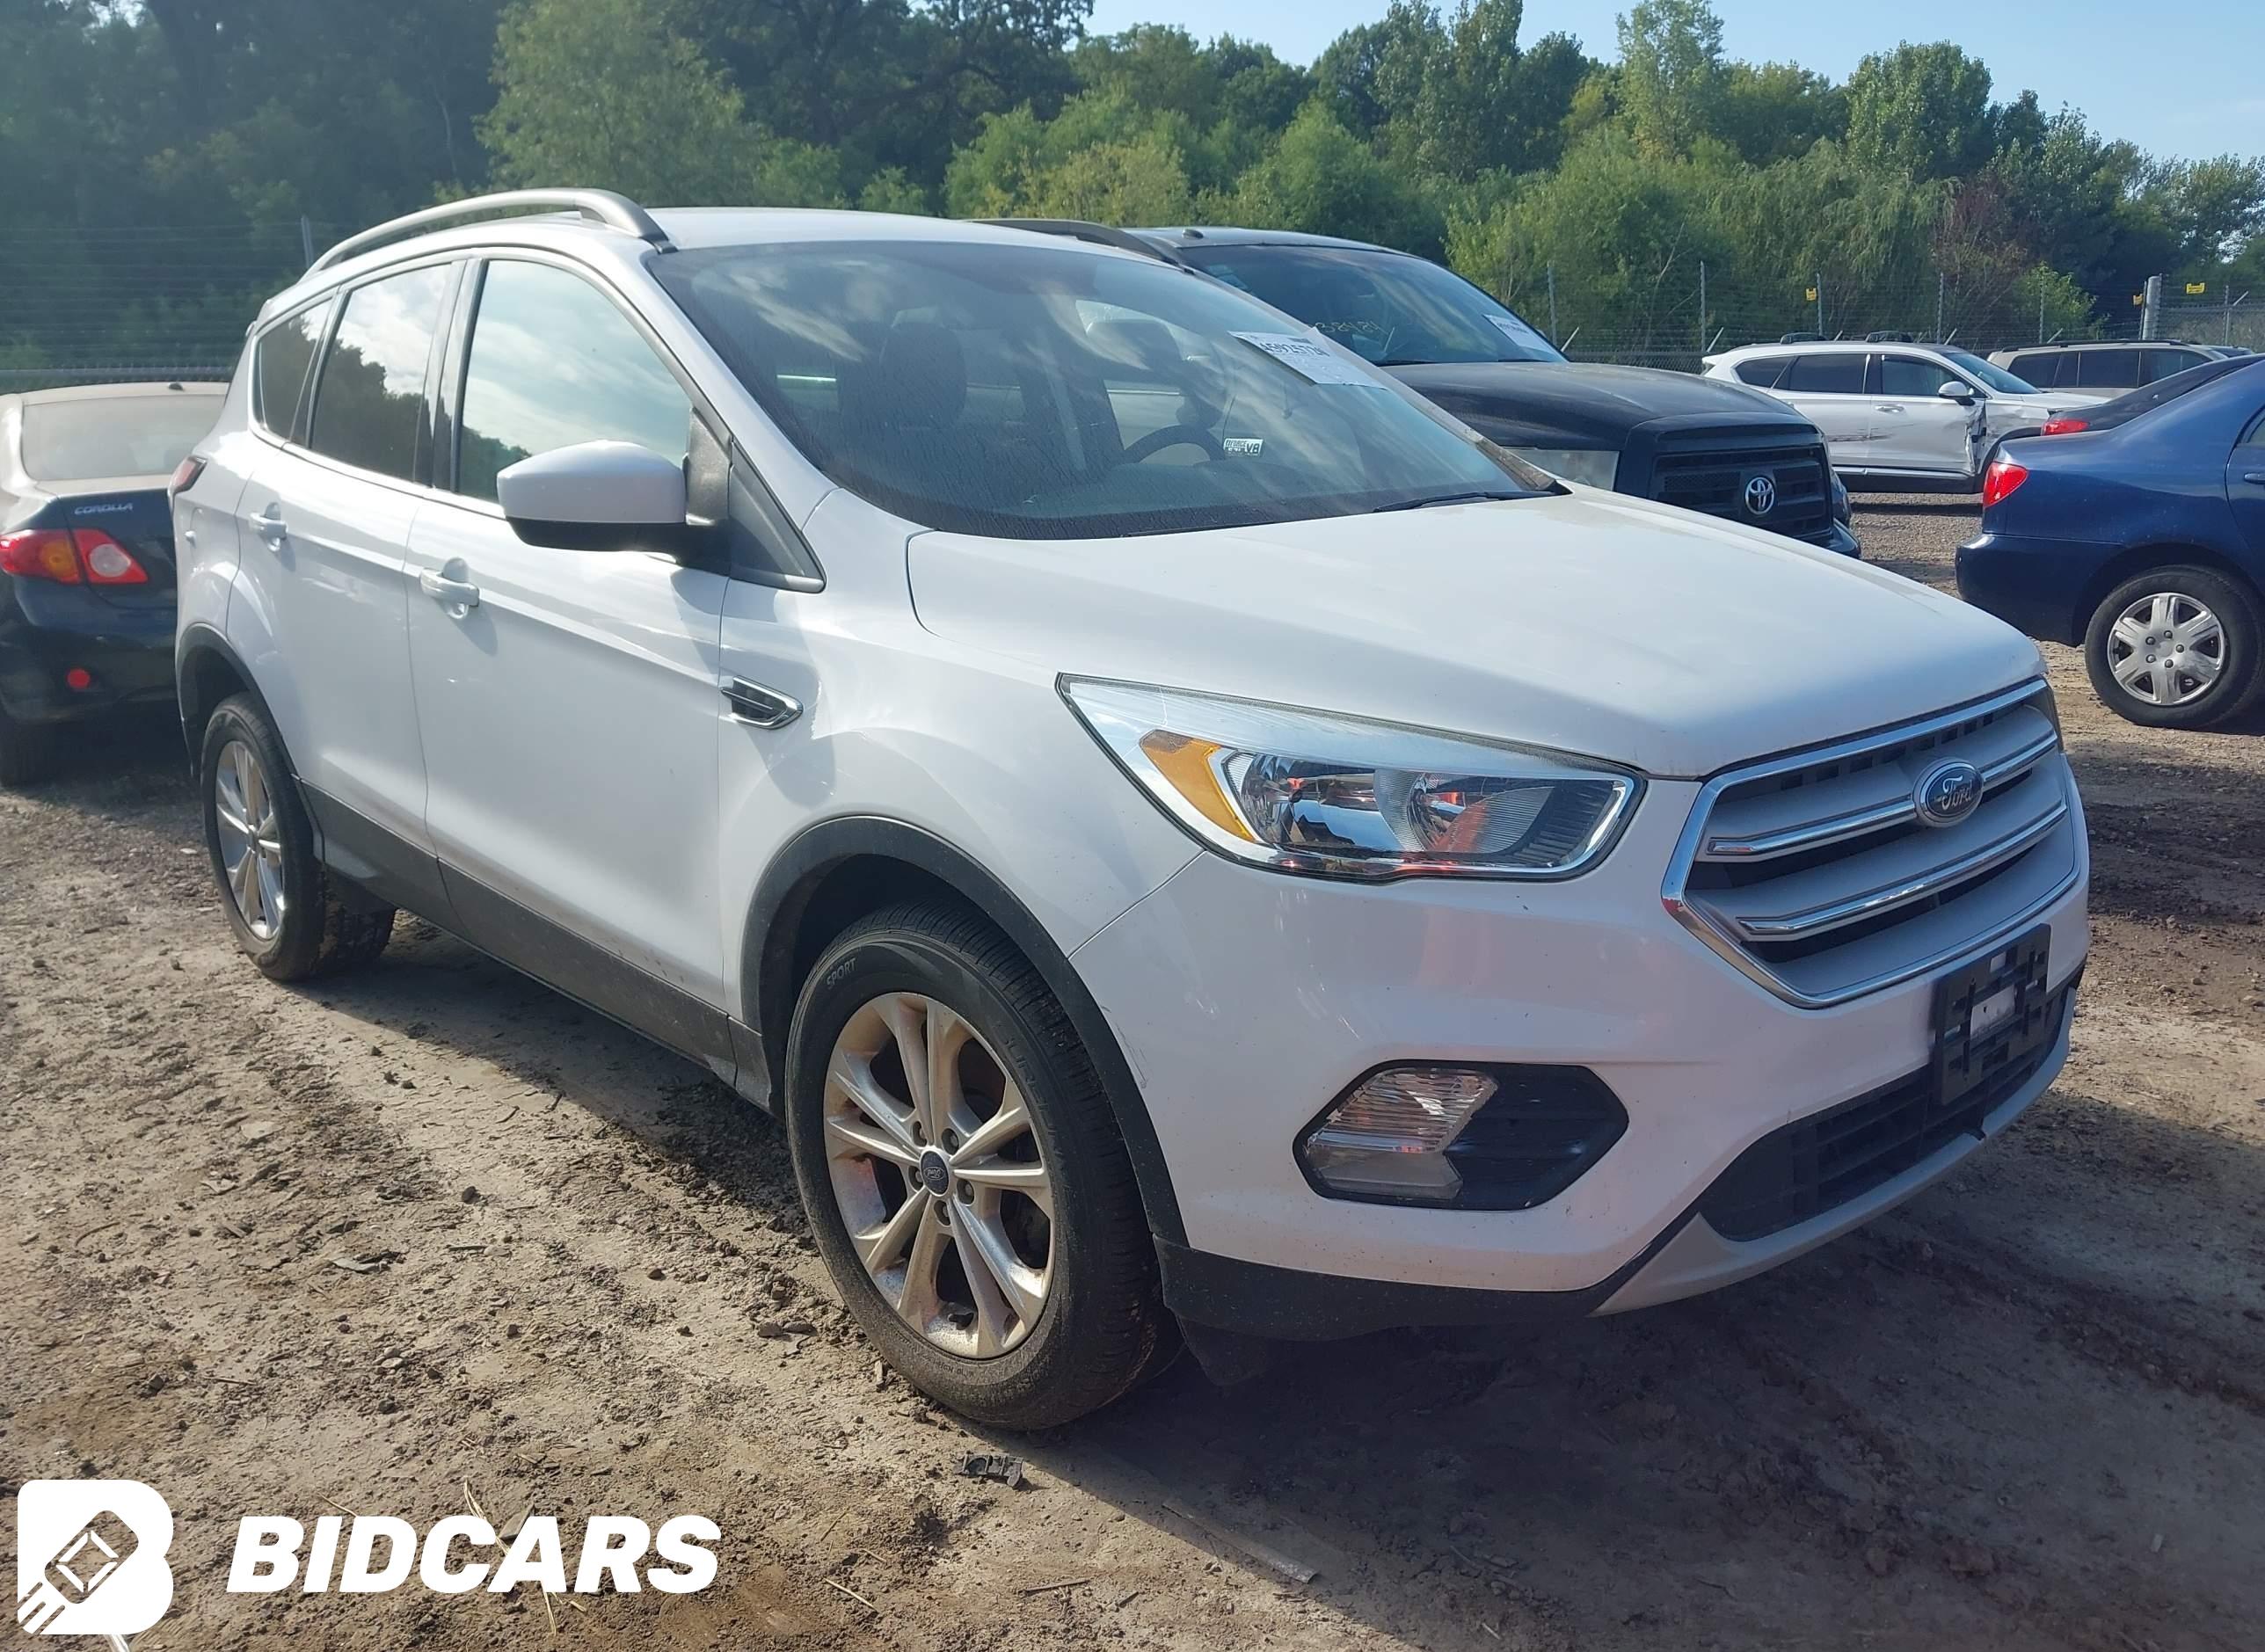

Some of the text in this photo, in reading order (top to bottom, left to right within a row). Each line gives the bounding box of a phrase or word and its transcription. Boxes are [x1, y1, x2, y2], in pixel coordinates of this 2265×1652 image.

[1246, 442, 1260, 454] V8
[74, 502, 134, 515] COROLLA
[1941, 775, 1974, 811] Ford
[826, 957, 856, 989] SPORT
